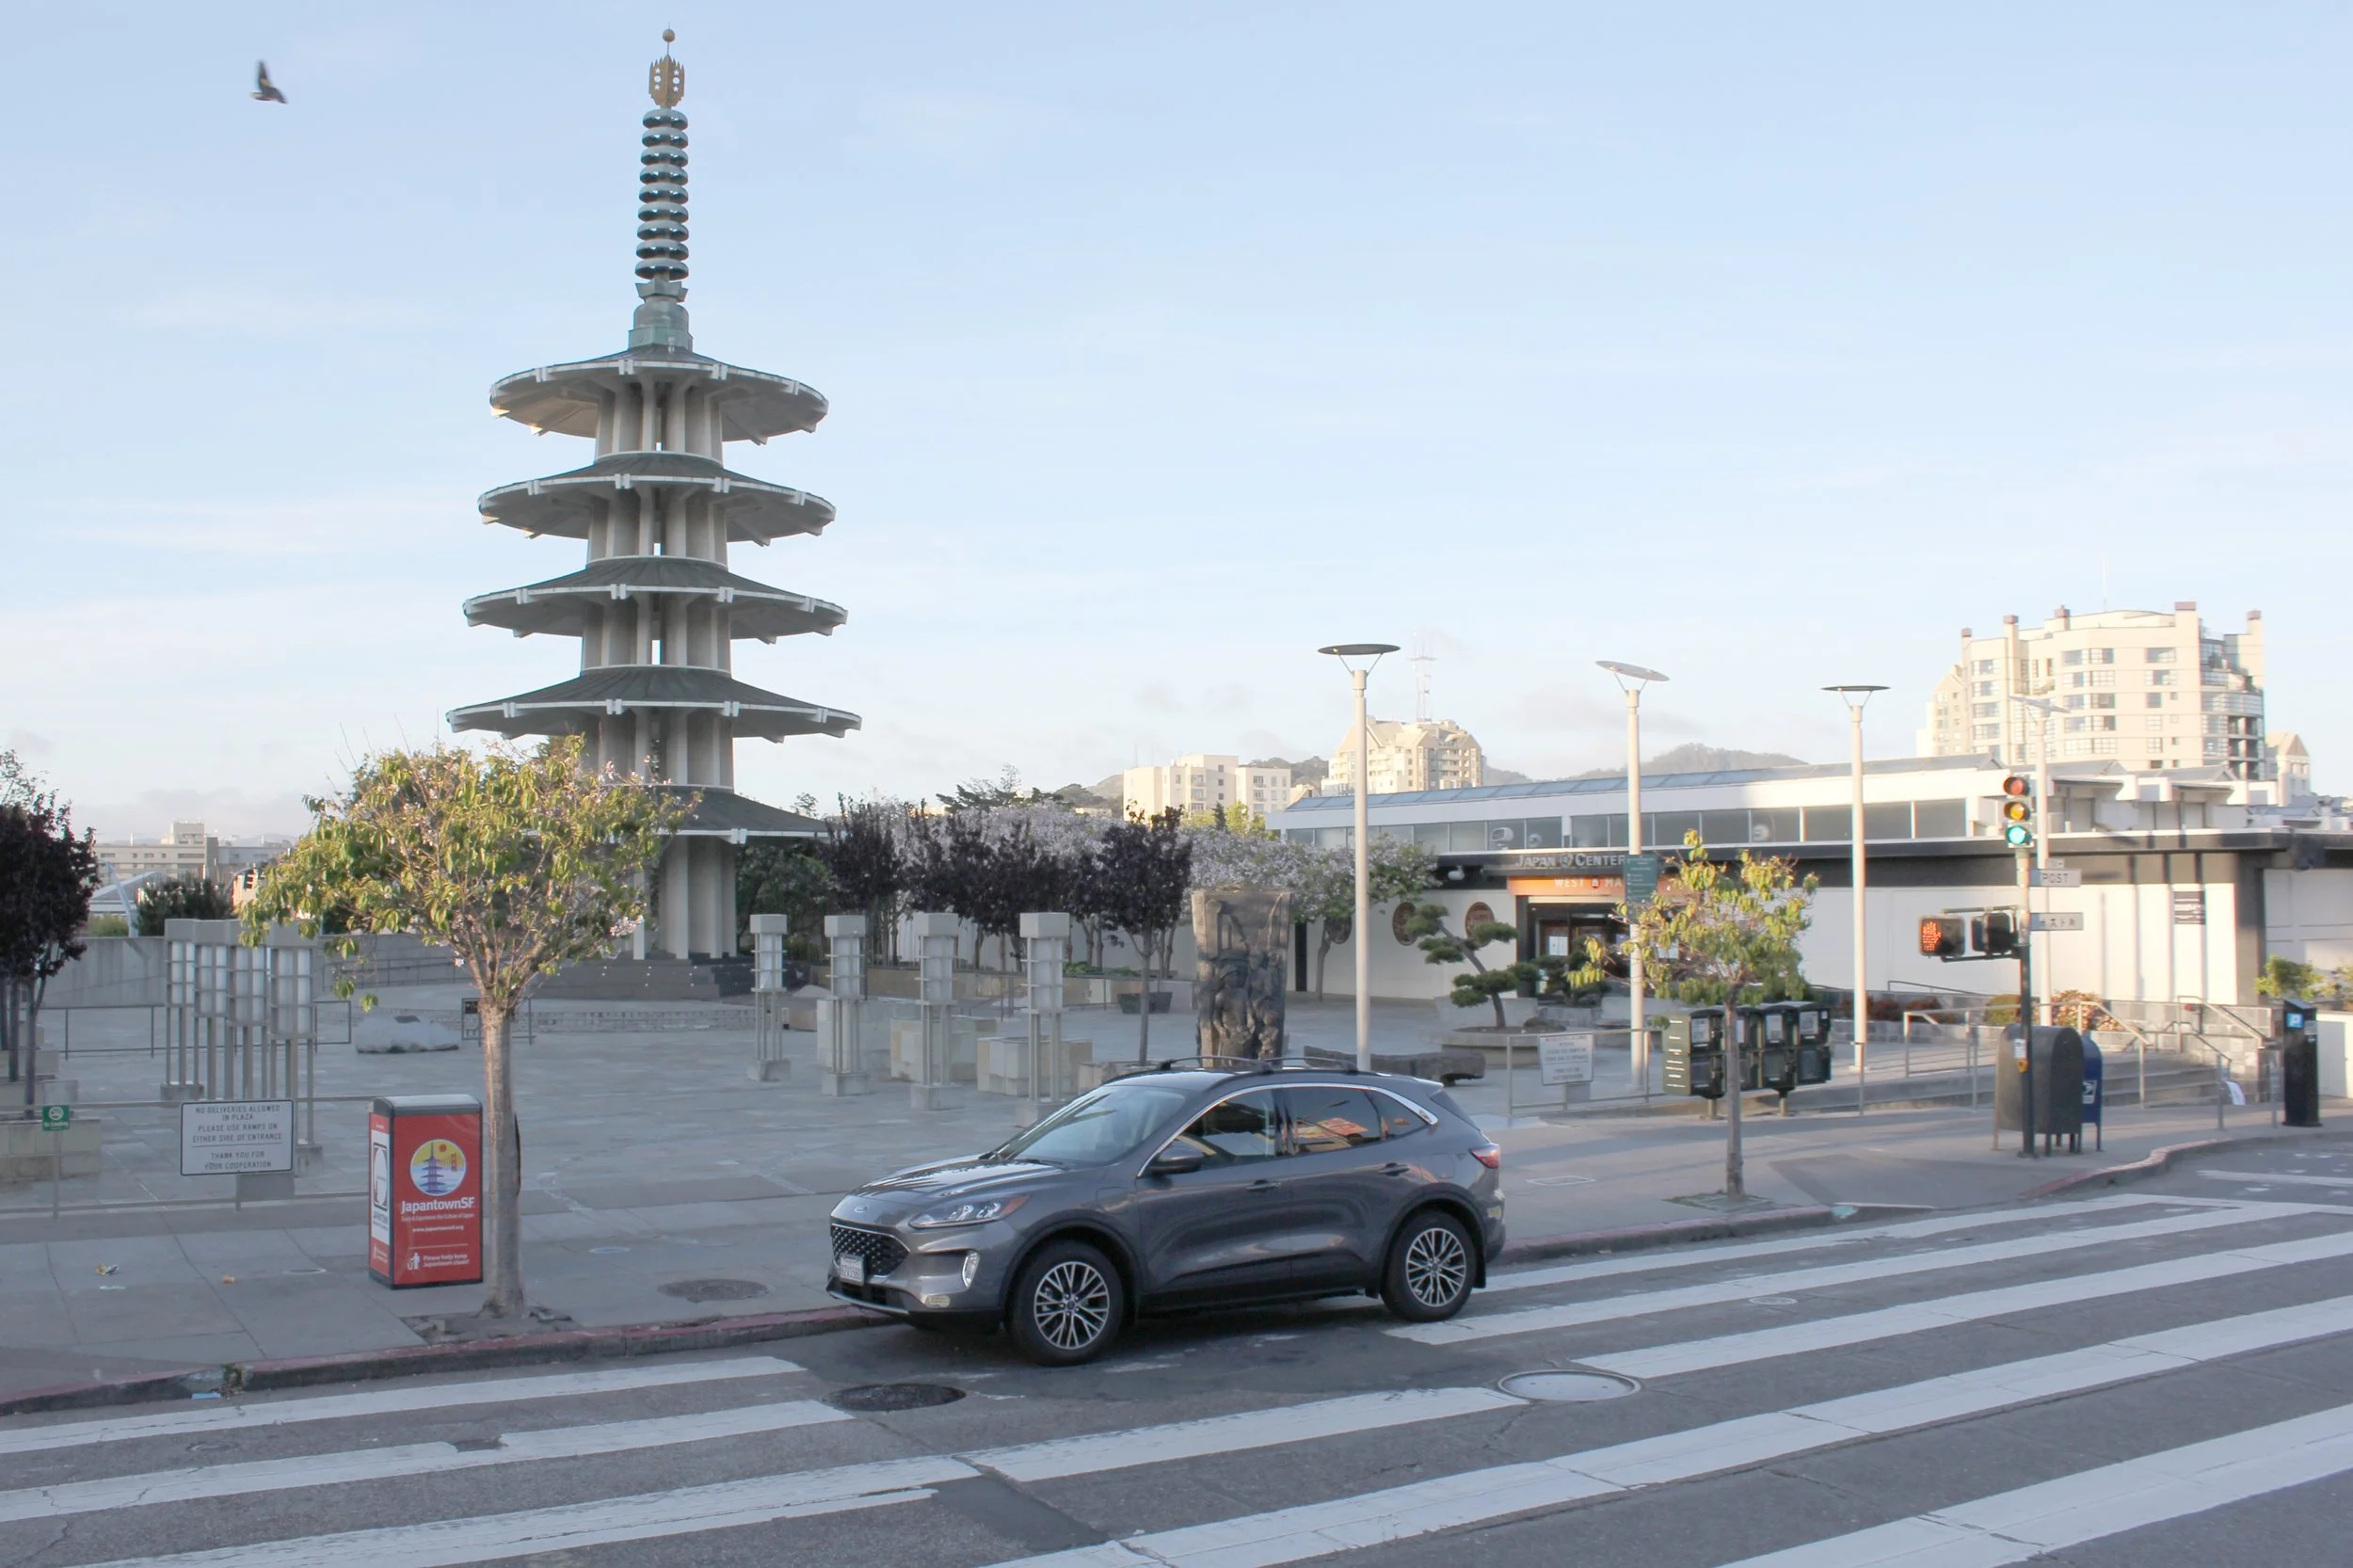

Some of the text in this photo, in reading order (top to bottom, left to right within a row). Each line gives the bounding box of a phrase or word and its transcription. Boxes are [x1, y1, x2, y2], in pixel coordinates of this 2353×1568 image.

[1515, 853, 1625, 866] JAPAN CENTER
[1554, 877, 1623, 888] WEST MA
[2042, 873, 2069, 883] POST
[207, 1105, 247, 1114] DELIVERIES
[198, 1125, 224, 1133] PLEASE
[401, 1197, 474, 1214] JapantownSF
